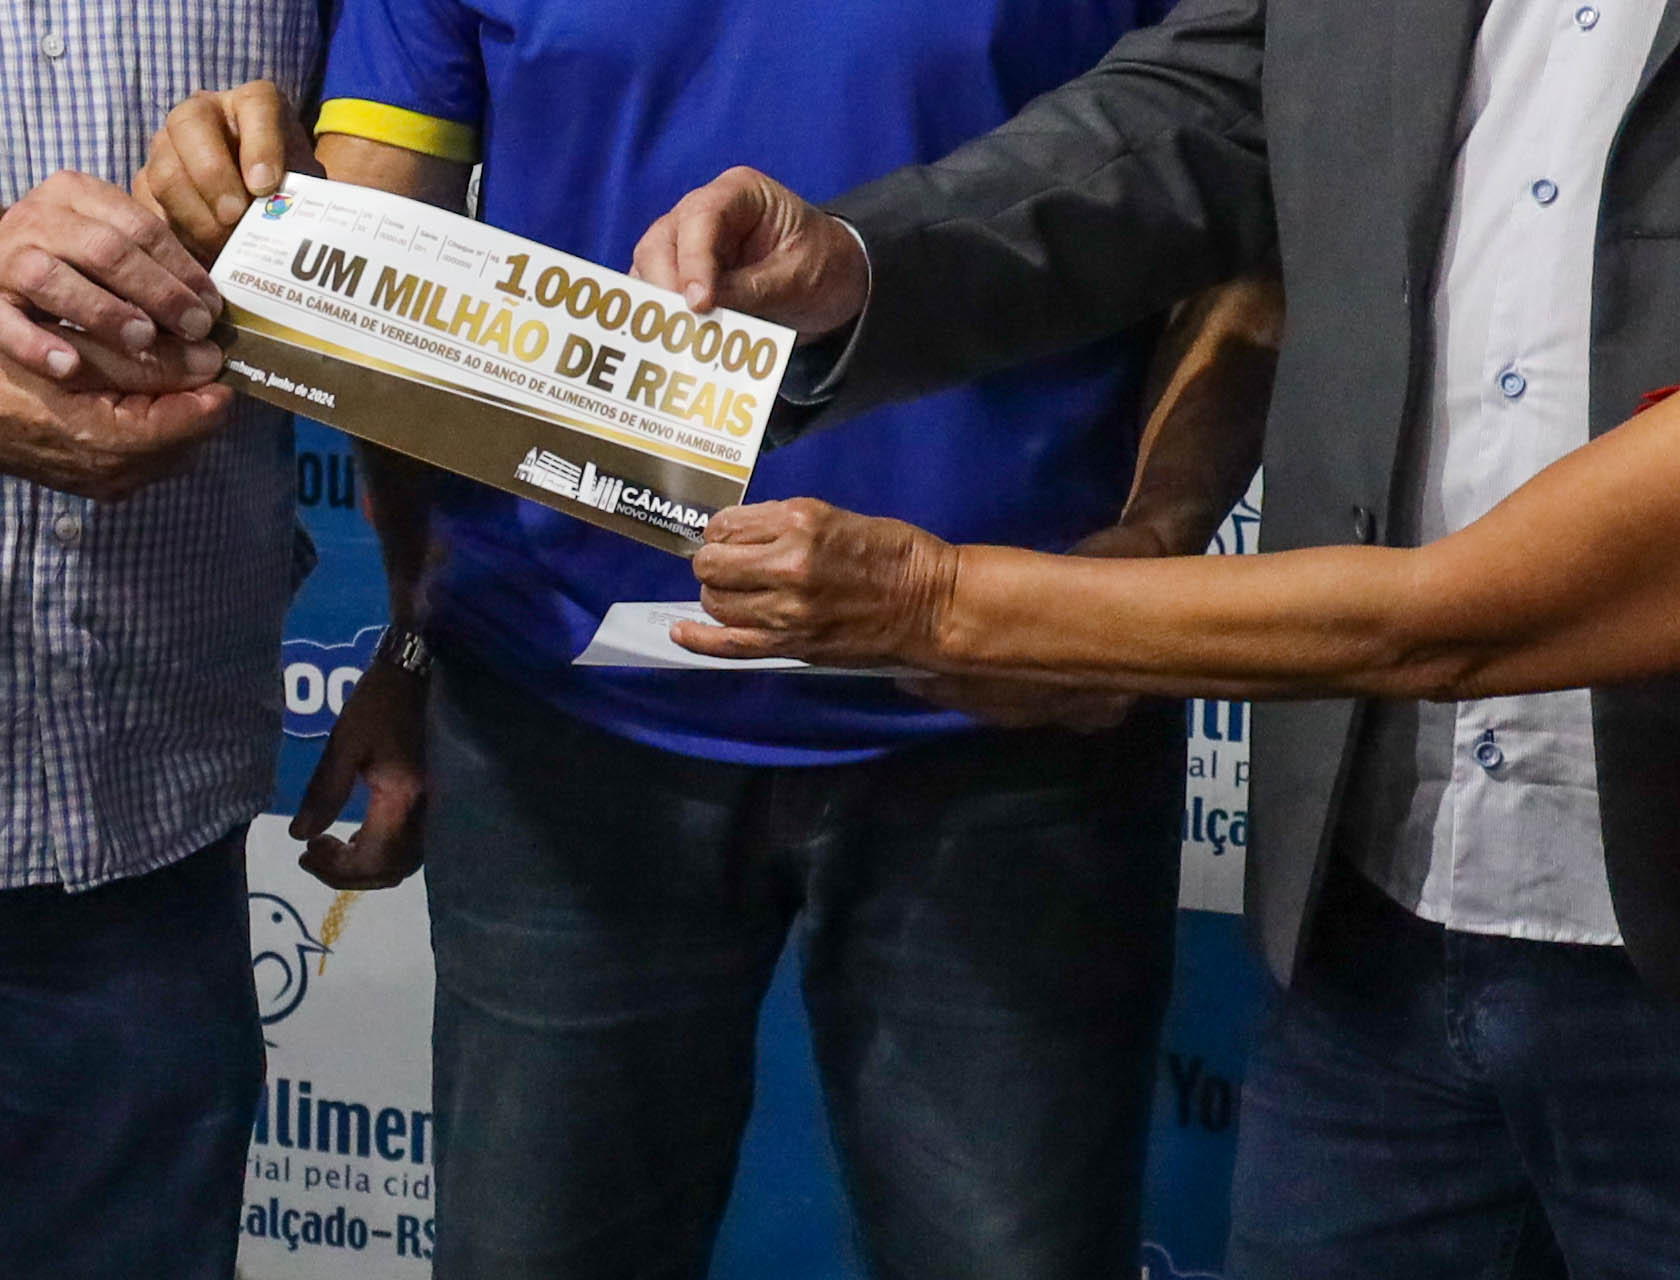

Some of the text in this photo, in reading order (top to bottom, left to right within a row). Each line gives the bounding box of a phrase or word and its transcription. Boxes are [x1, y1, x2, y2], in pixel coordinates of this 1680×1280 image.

[290, 238, 368, 298] UM
[370, 265, 550, 363] MILHÃO
[554, 333, 626, 394] DE
[626, 359, 758, 438] REAIS
[229, 269, 742, 463] REPASSE DA CÂMARA DE VEREADORES AO BANCO DE ALIMENTOS DE NOVO HAMBURGO
[267, 372, 295, 394] junho
[295, 381, 308, 397] de
[307, 387, 337, 408] 2024.
[616, 503, 647, 522] NOVO
[621, 486, 710, 529] CÂMARA
[304, 1160, 372, 1194] pela
[239, 1197, 436, 1260] alçado-R
